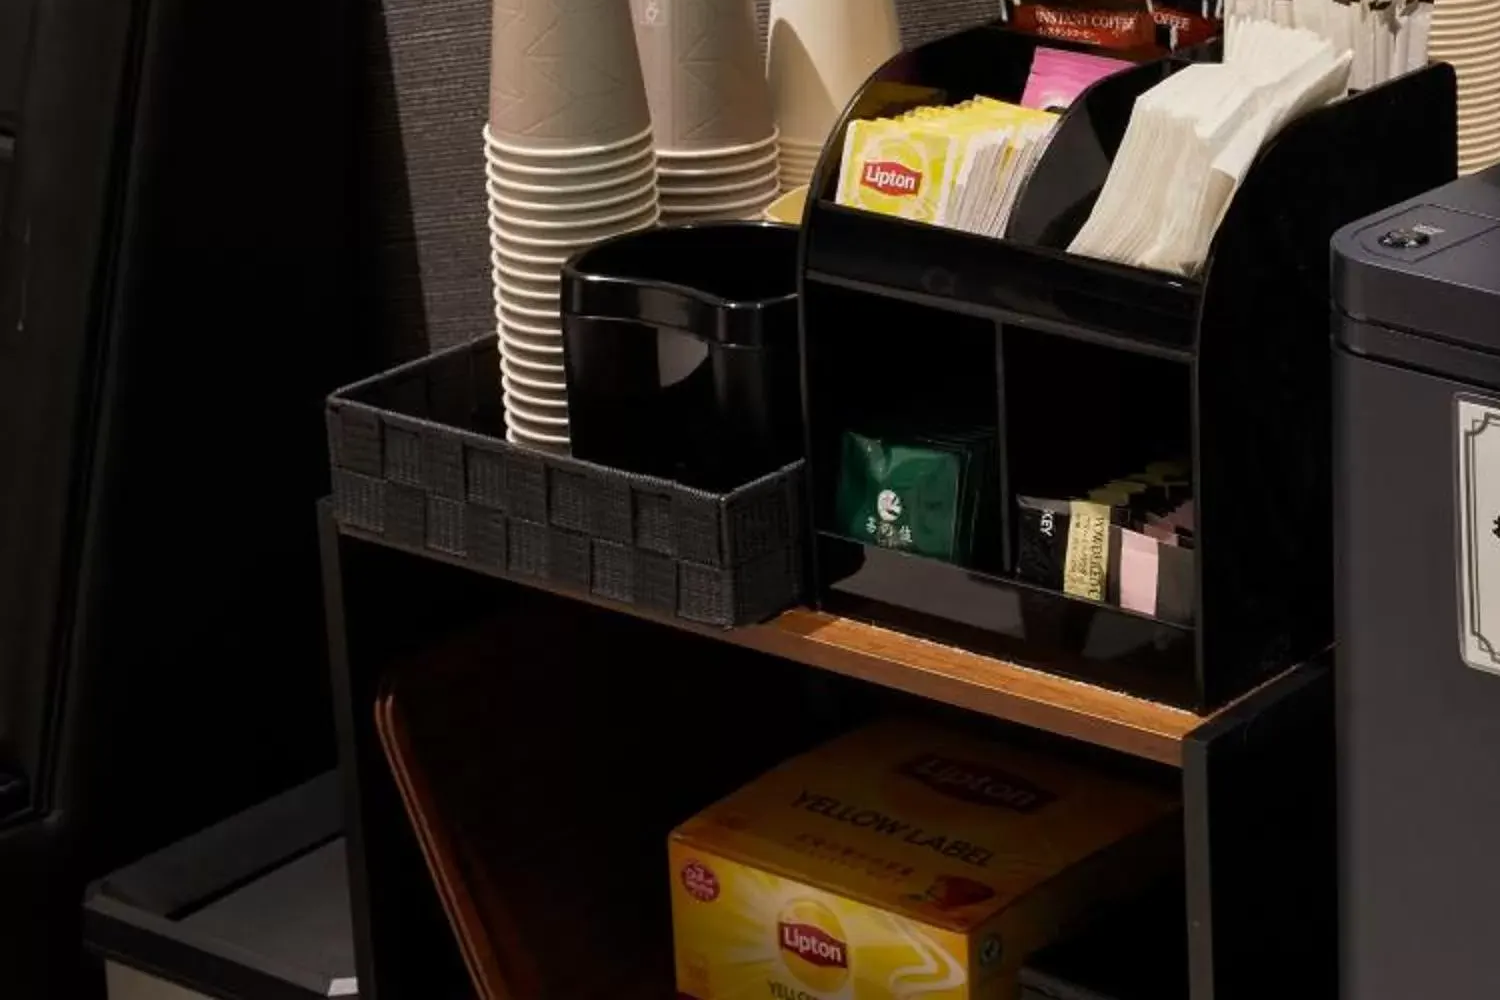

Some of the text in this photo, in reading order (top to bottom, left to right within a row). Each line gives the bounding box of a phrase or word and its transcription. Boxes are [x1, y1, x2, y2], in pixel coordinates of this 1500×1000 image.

[1152, 12, 1192, 32] OFFEE
[864, 165, 916, 190] Lipton
[914, 758, 1037, 807] Lipton
[789, 788, 911, 835] YELLOW
[903, 828, 995, 867] LABEL
[783, 926, 842, 963] Lipton
